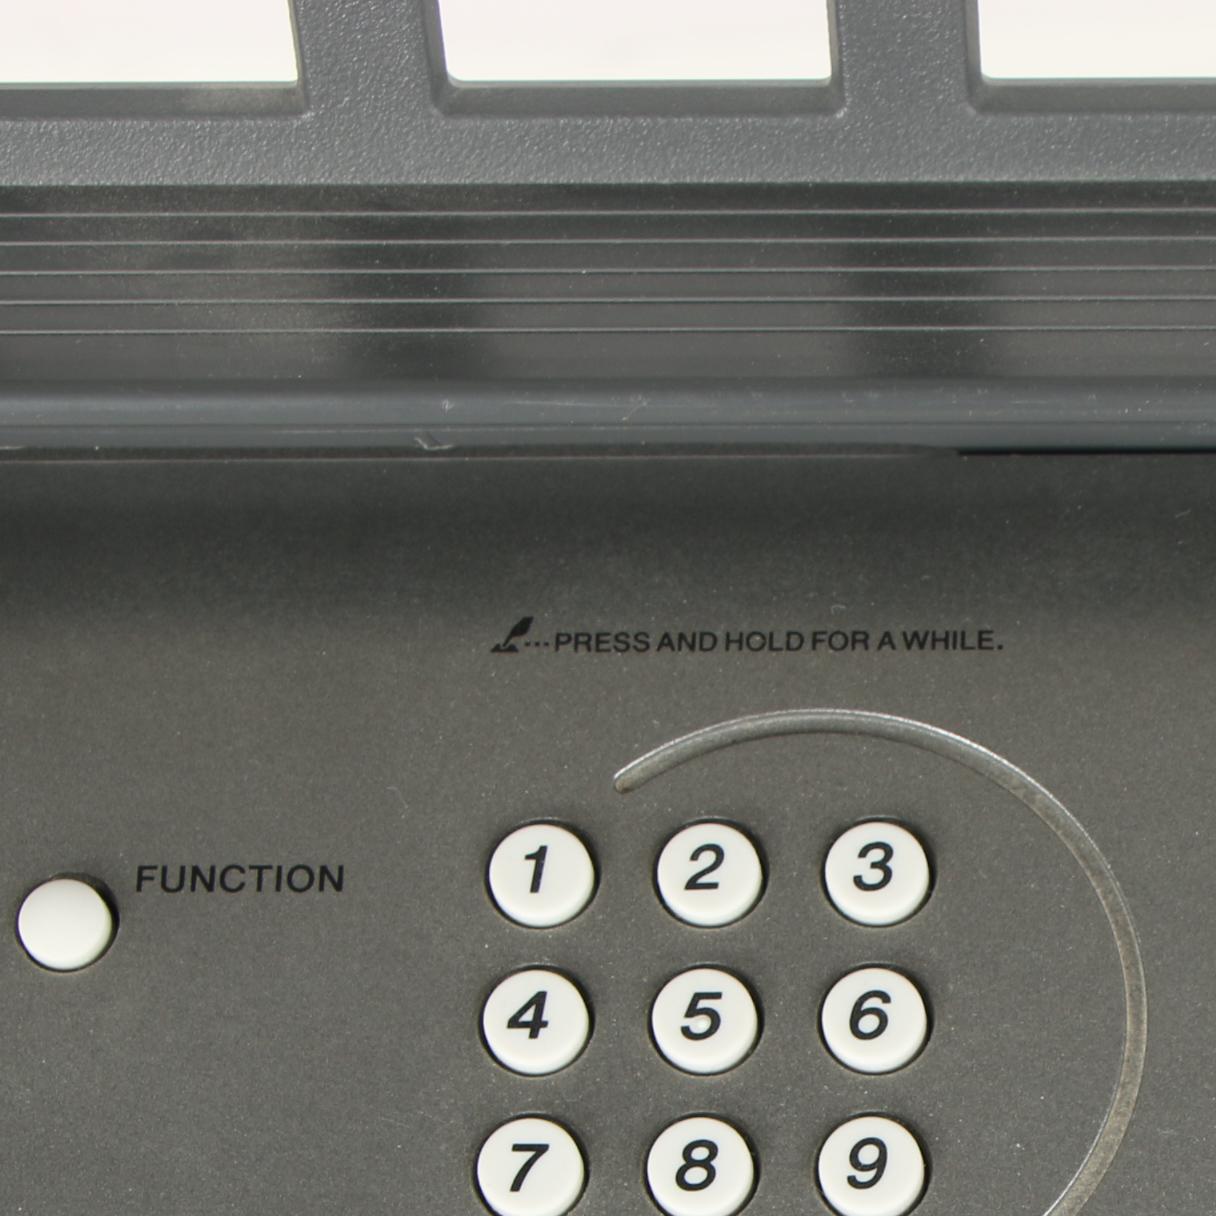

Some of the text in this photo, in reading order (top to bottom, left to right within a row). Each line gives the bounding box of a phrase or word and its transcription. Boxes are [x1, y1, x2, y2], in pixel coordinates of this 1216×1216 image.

[554, 629, 1003, 653] PRESS AND HOLD FOR A WHILE.
[135, 864, 344, 894] FUNCTION
[524, 845, 548, 894] 1
[684, 843, 725, 891] 2
[852, 841, 894, 892] 3
[506, 990, 549, 1040] 4
[680, 991, 723, 1042] 5
[848, 989, 892, 1041] 6
[509, 1143, 550, 1193] 7
[674, 1138, 719, 1192] 8
[846, 1136, 888, 1190] 9
